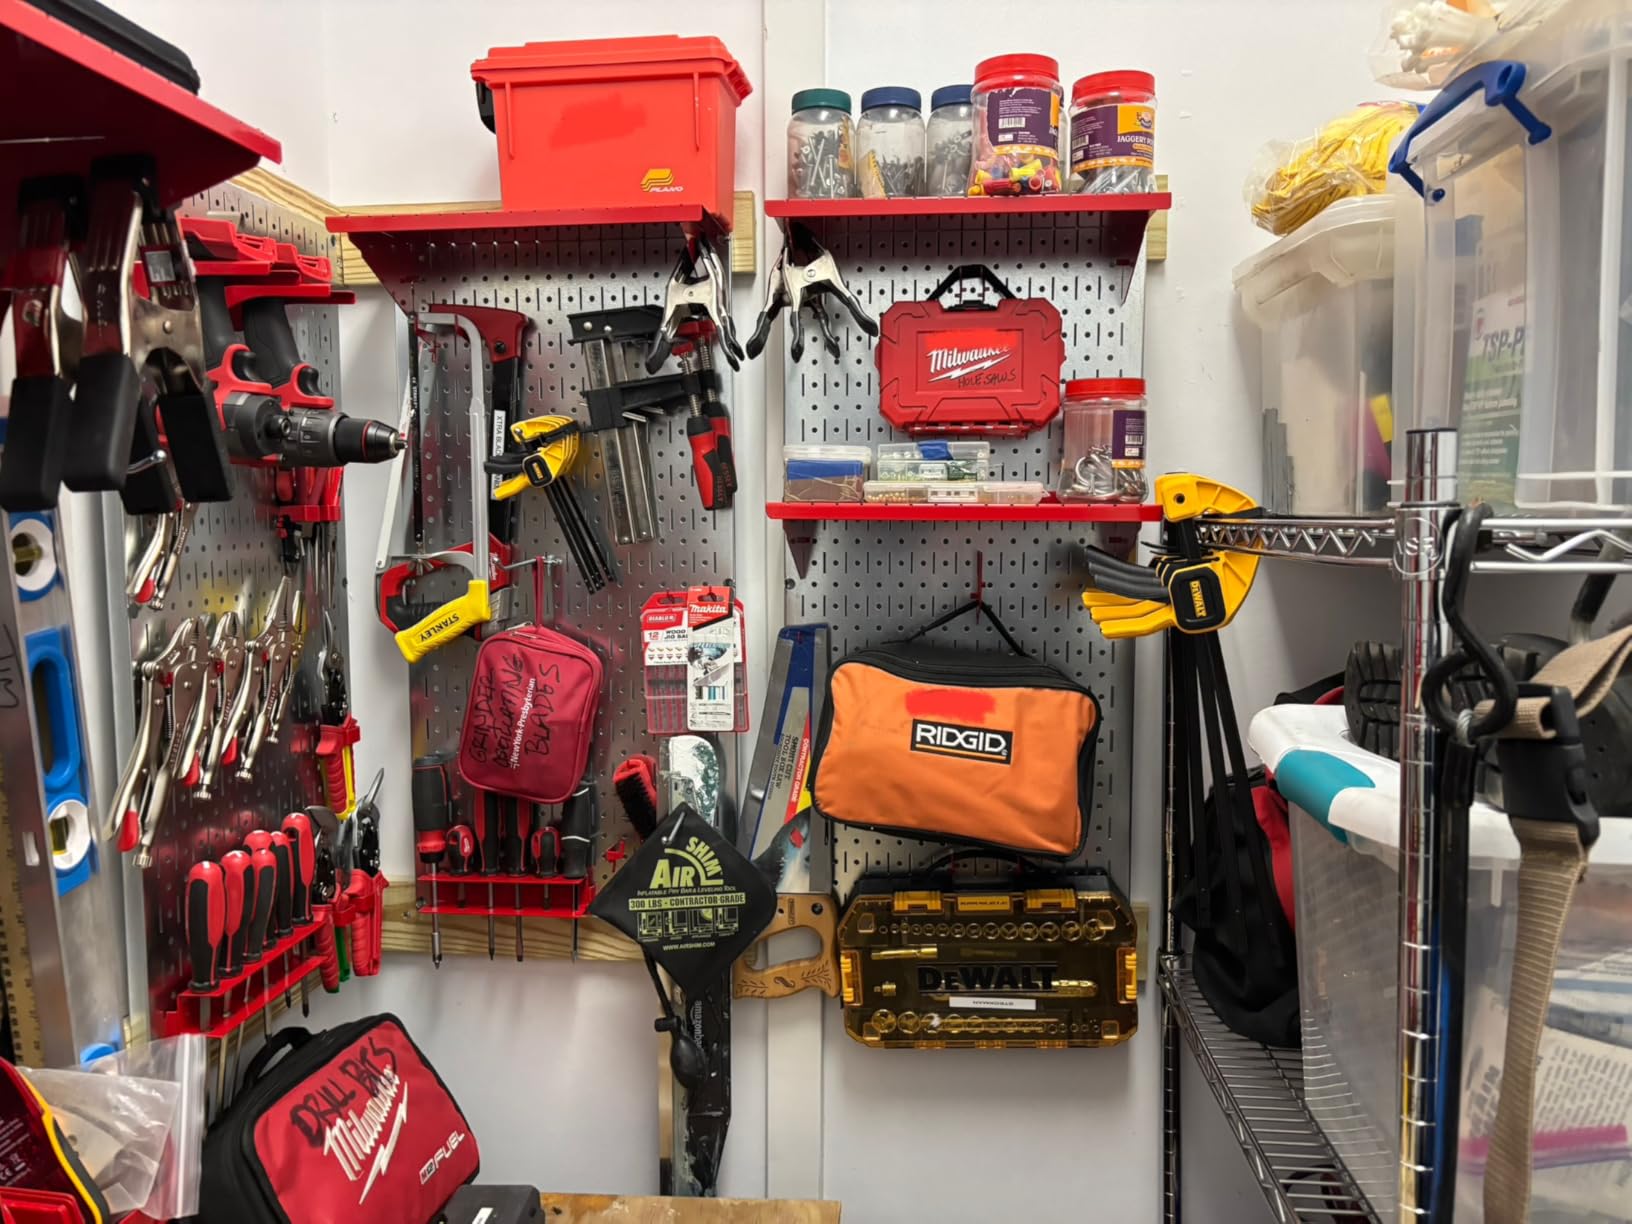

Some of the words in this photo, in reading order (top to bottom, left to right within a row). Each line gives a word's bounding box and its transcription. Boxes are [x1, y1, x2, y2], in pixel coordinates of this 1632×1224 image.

[1117, 135, 1147, 144] JAGGERY
[958, 373, 983, 388] HOLE
[495, 436, 503, 456] BLAD
[419, 613, 460, 642] STANLEY
[648, 631, 659, 640] 12
[469, 667, 496, 763] GRINDER
[524, 663, 560, 756] BLADES
[781, 734, 791, 756] TOOL
[791, 736, 799, 763] SHORT
[915, 723, 1007, 752] RIDGID
[784, 763, 793, 780] CUT
[795, 738, 809, 781] CONTRACTOR
[791, 780, 801, 802] GRADE
[686, 836, 722, 877] SHIM
[649, 859, 696, 889] AIR
[630, 899, 646, 909] 300
[648, 899, 663, 908] LBS
[694, 1000, 704, 1050] amazonba
[290, 1079, 357, 1148] DRILL
[324, 1064, 401, 1181] Milwaukee
[434, 1130, 465, 1168] FUEL
